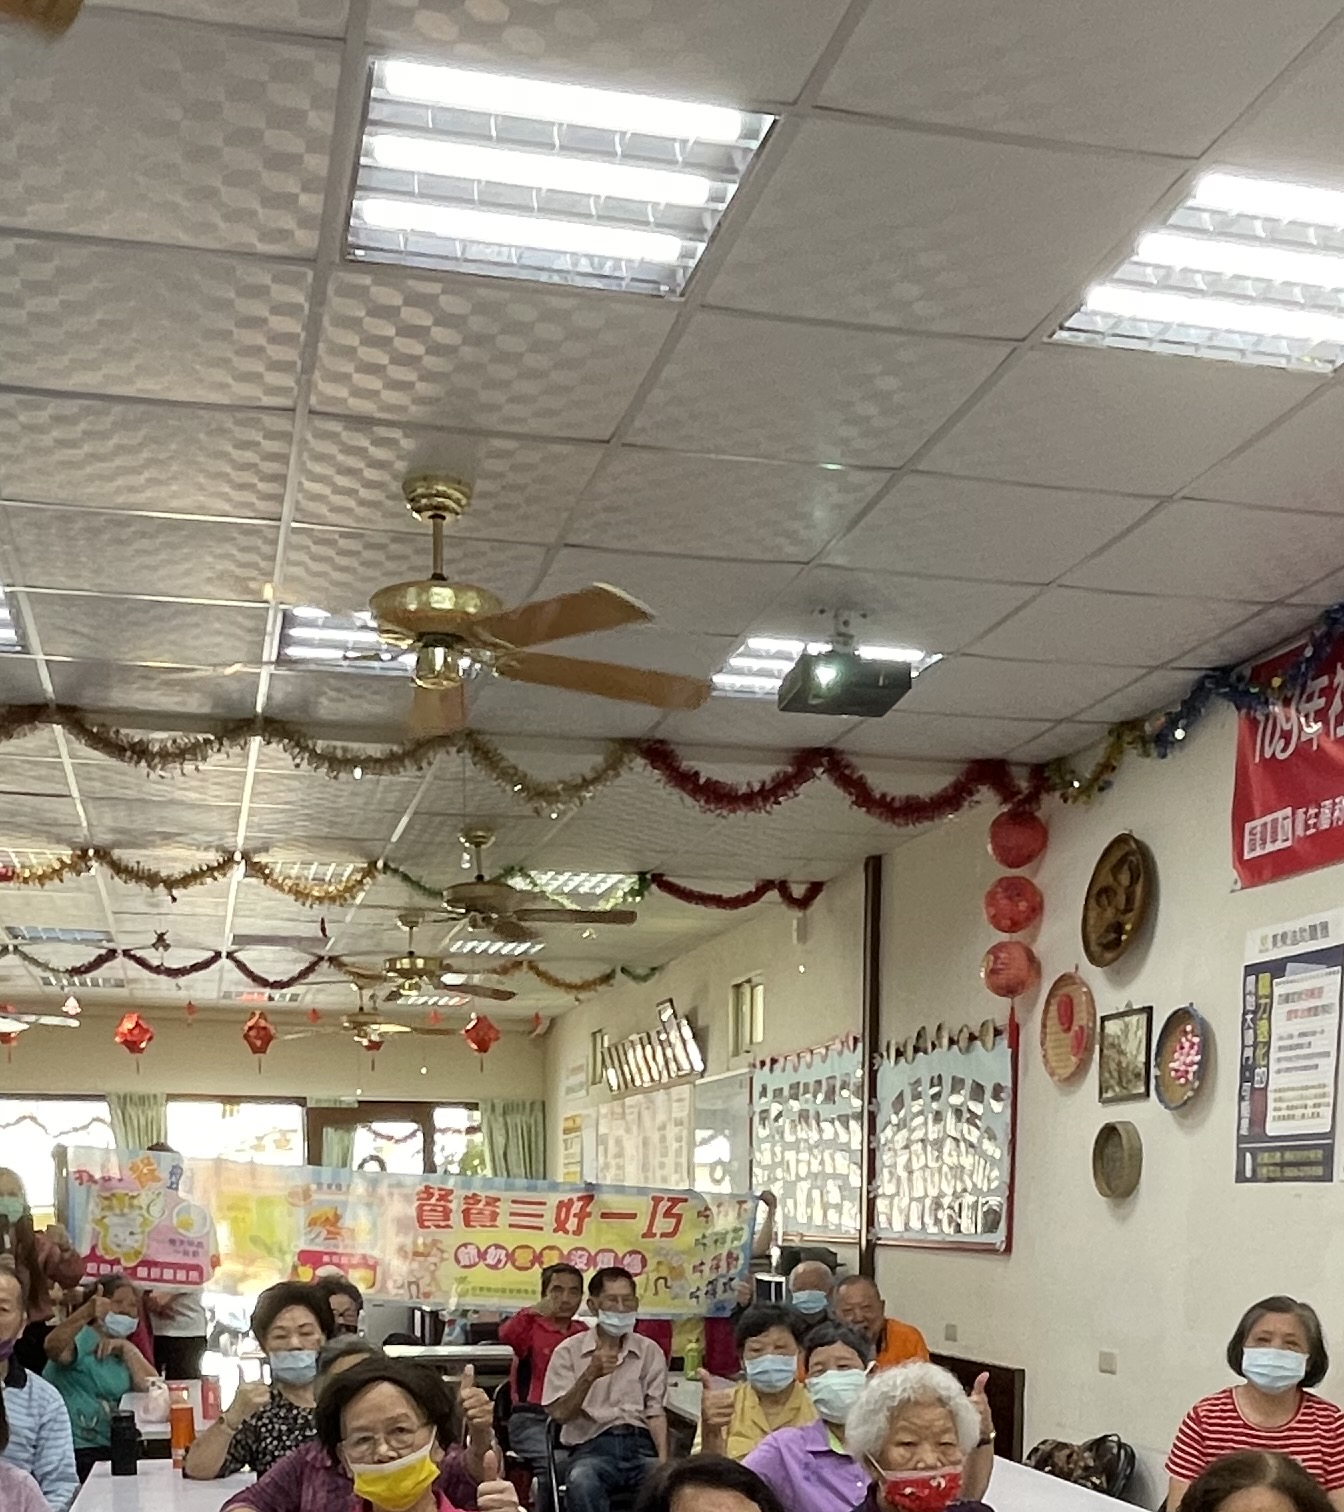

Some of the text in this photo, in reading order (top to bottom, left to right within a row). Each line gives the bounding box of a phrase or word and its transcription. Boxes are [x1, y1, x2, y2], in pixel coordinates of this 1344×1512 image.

[414, 1184, 690, 1240] 餐餐三好一巧
